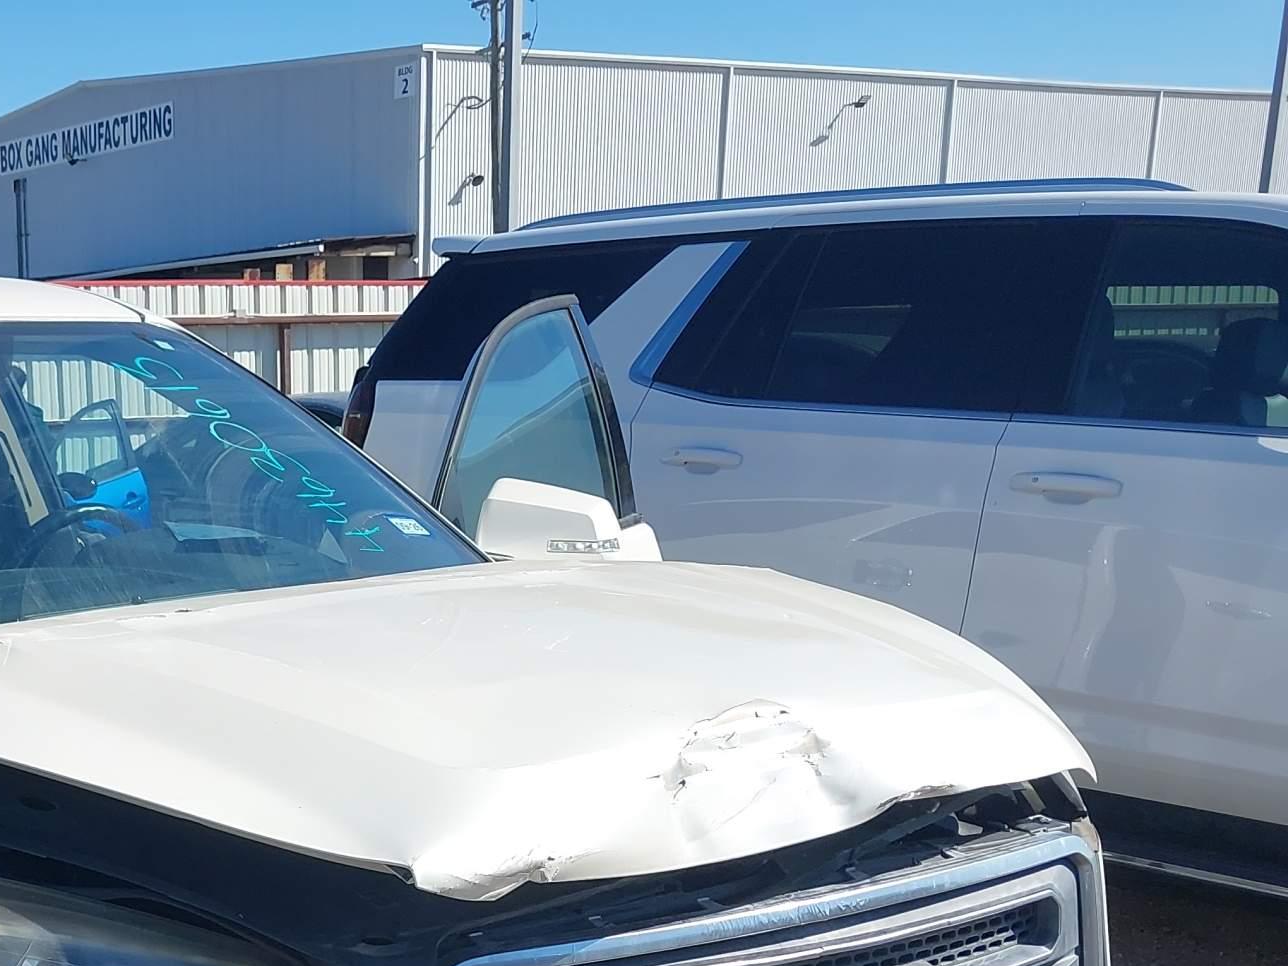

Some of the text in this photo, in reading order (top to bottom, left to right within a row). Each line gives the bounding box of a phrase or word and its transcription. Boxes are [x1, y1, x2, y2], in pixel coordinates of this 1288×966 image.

[398, 64, 413, 76] BLDG
[402, 78, 409, 94] 2
[0, 104, 173, 173] BOX GANG MANUFACTURING
